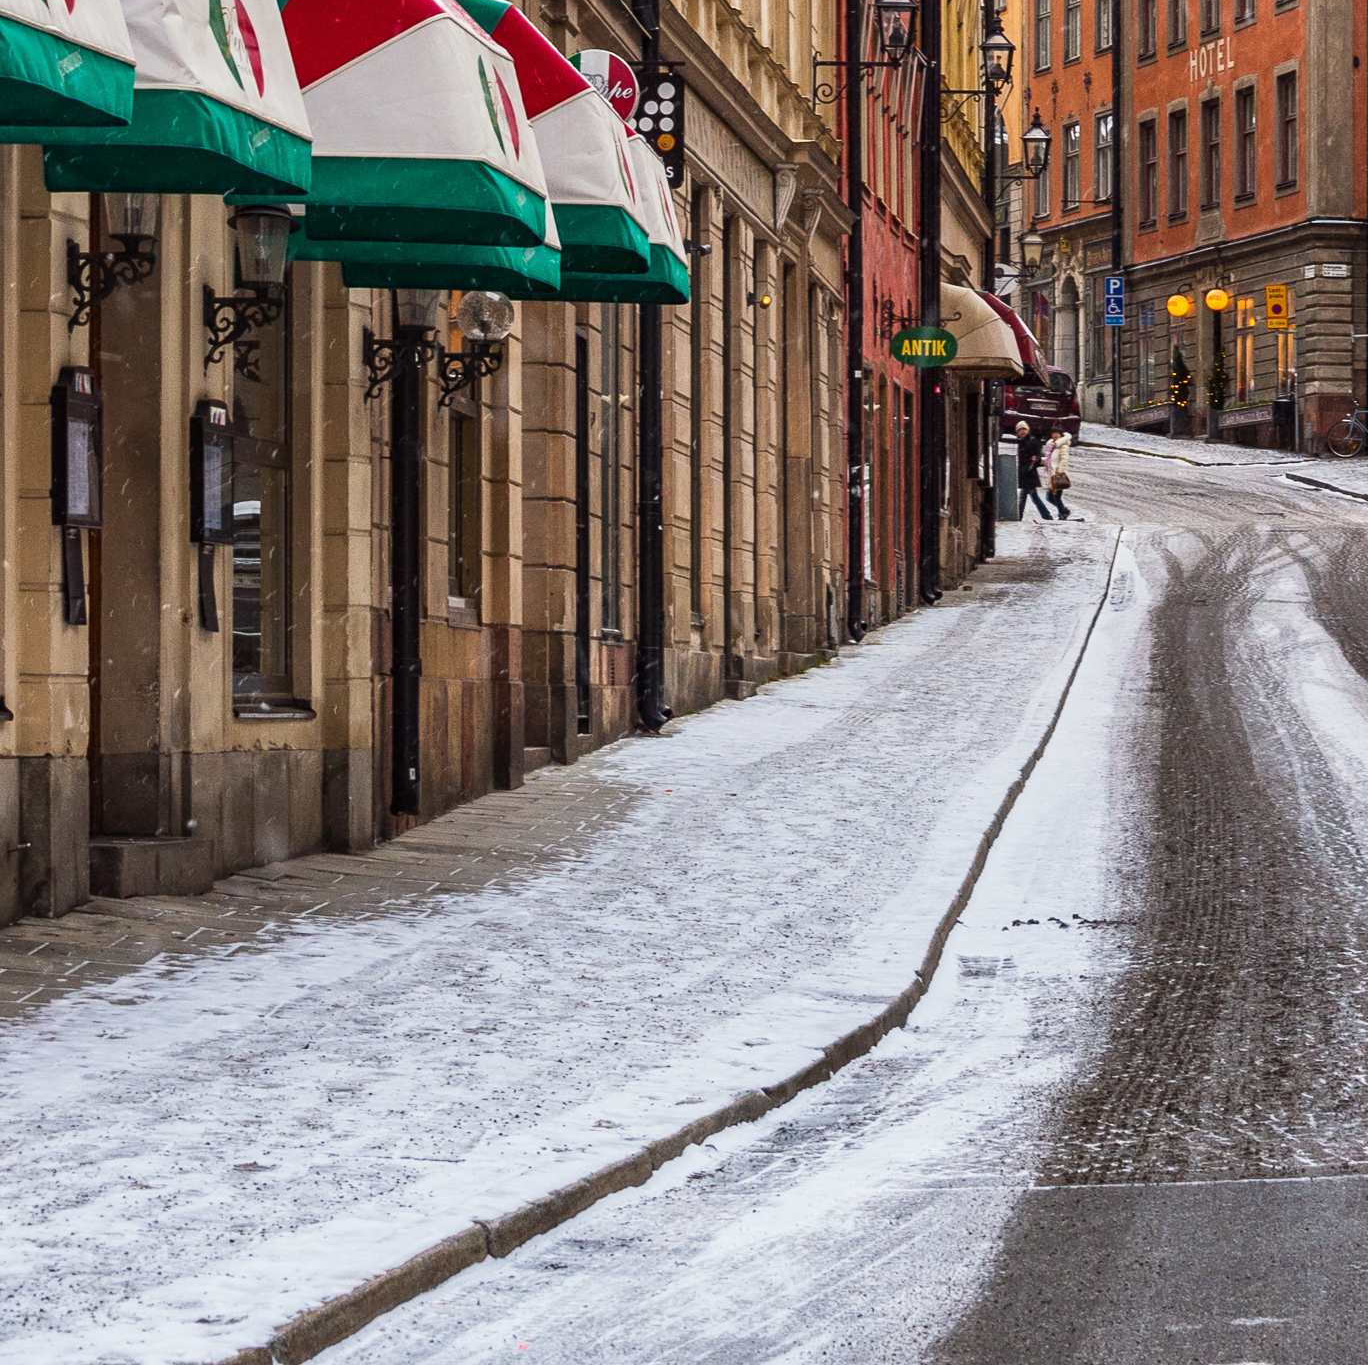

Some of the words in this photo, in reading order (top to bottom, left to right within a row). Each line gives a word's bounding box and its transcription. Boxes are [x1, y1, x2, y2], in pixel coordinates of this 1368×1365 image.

[1190, 36, 1235, 83] HOTEL
[582, 73, 633, 101] ppe
[1110, 279, 1120, 294] P
[901, 339, 946, 356] ANTIK
